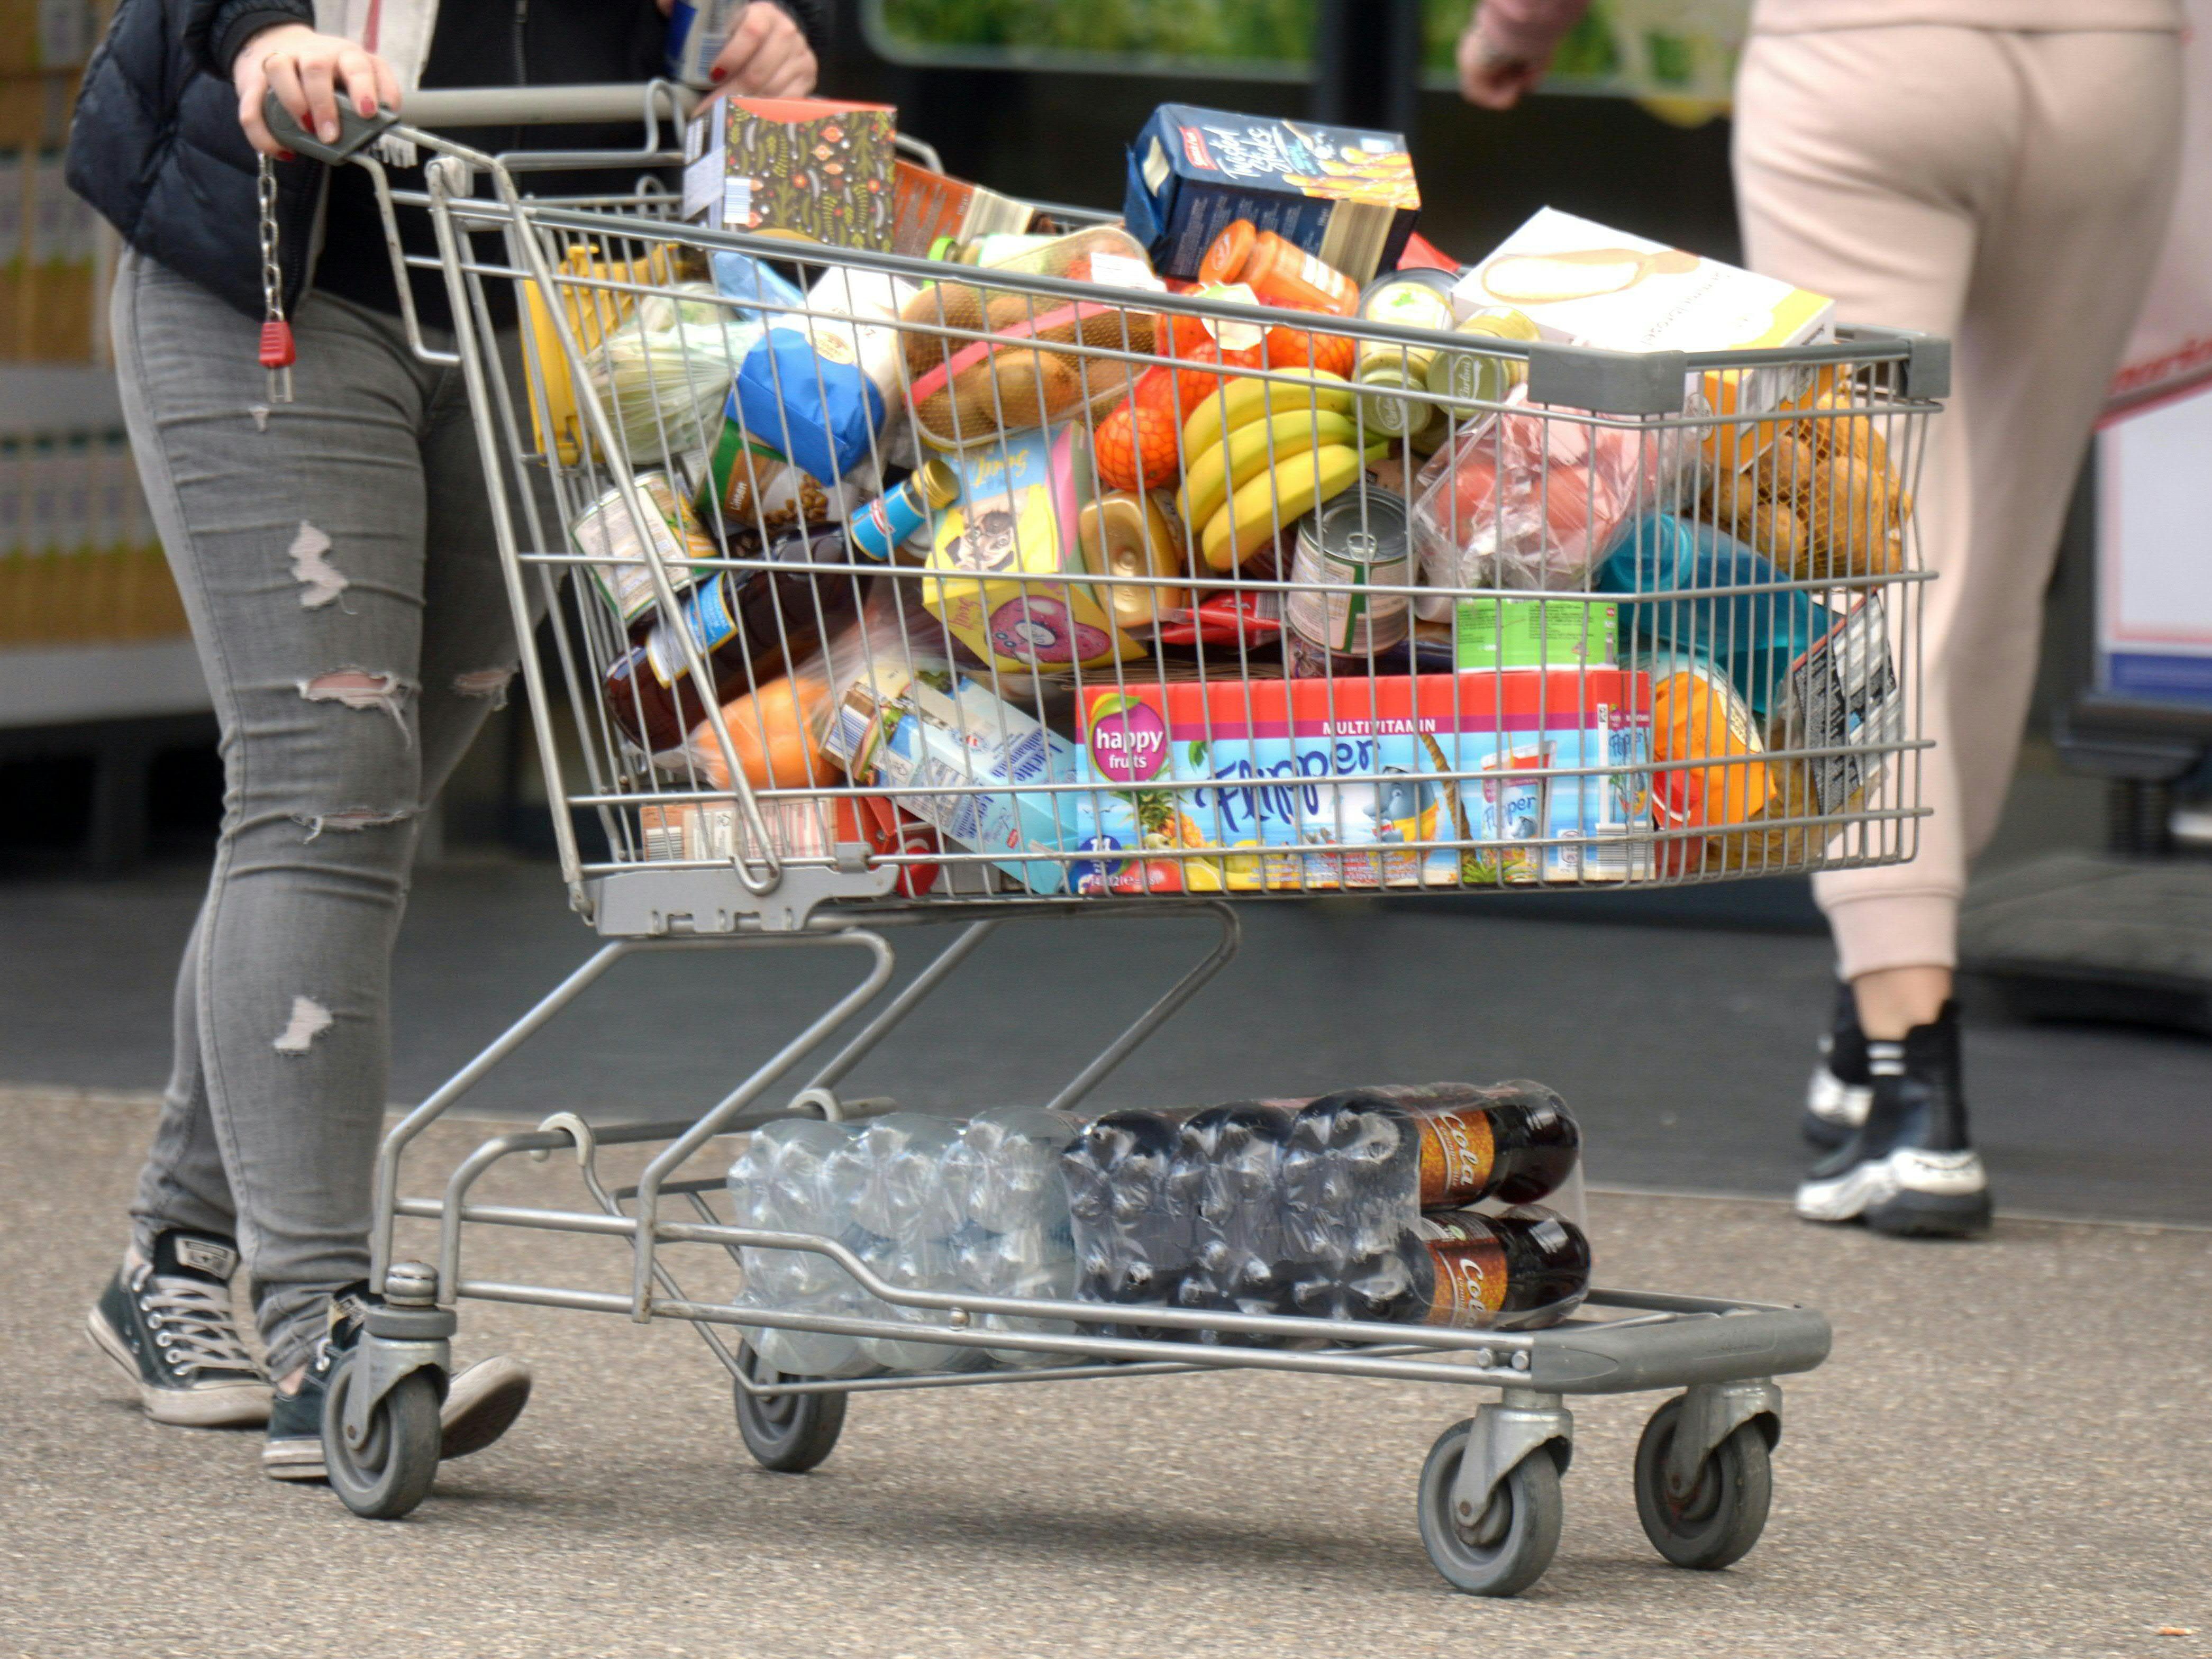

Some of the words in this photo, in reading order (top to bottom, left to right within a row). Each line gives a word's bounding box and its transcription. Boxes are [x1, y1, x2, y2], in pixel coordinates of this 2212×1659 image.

[1097, 727, 1163, 753] happy
[1109, 754, 1147, 769] fruts
[1195, 740, 1381, 832] Flipper
[1438, 1111, 1480, 1186] Cola
